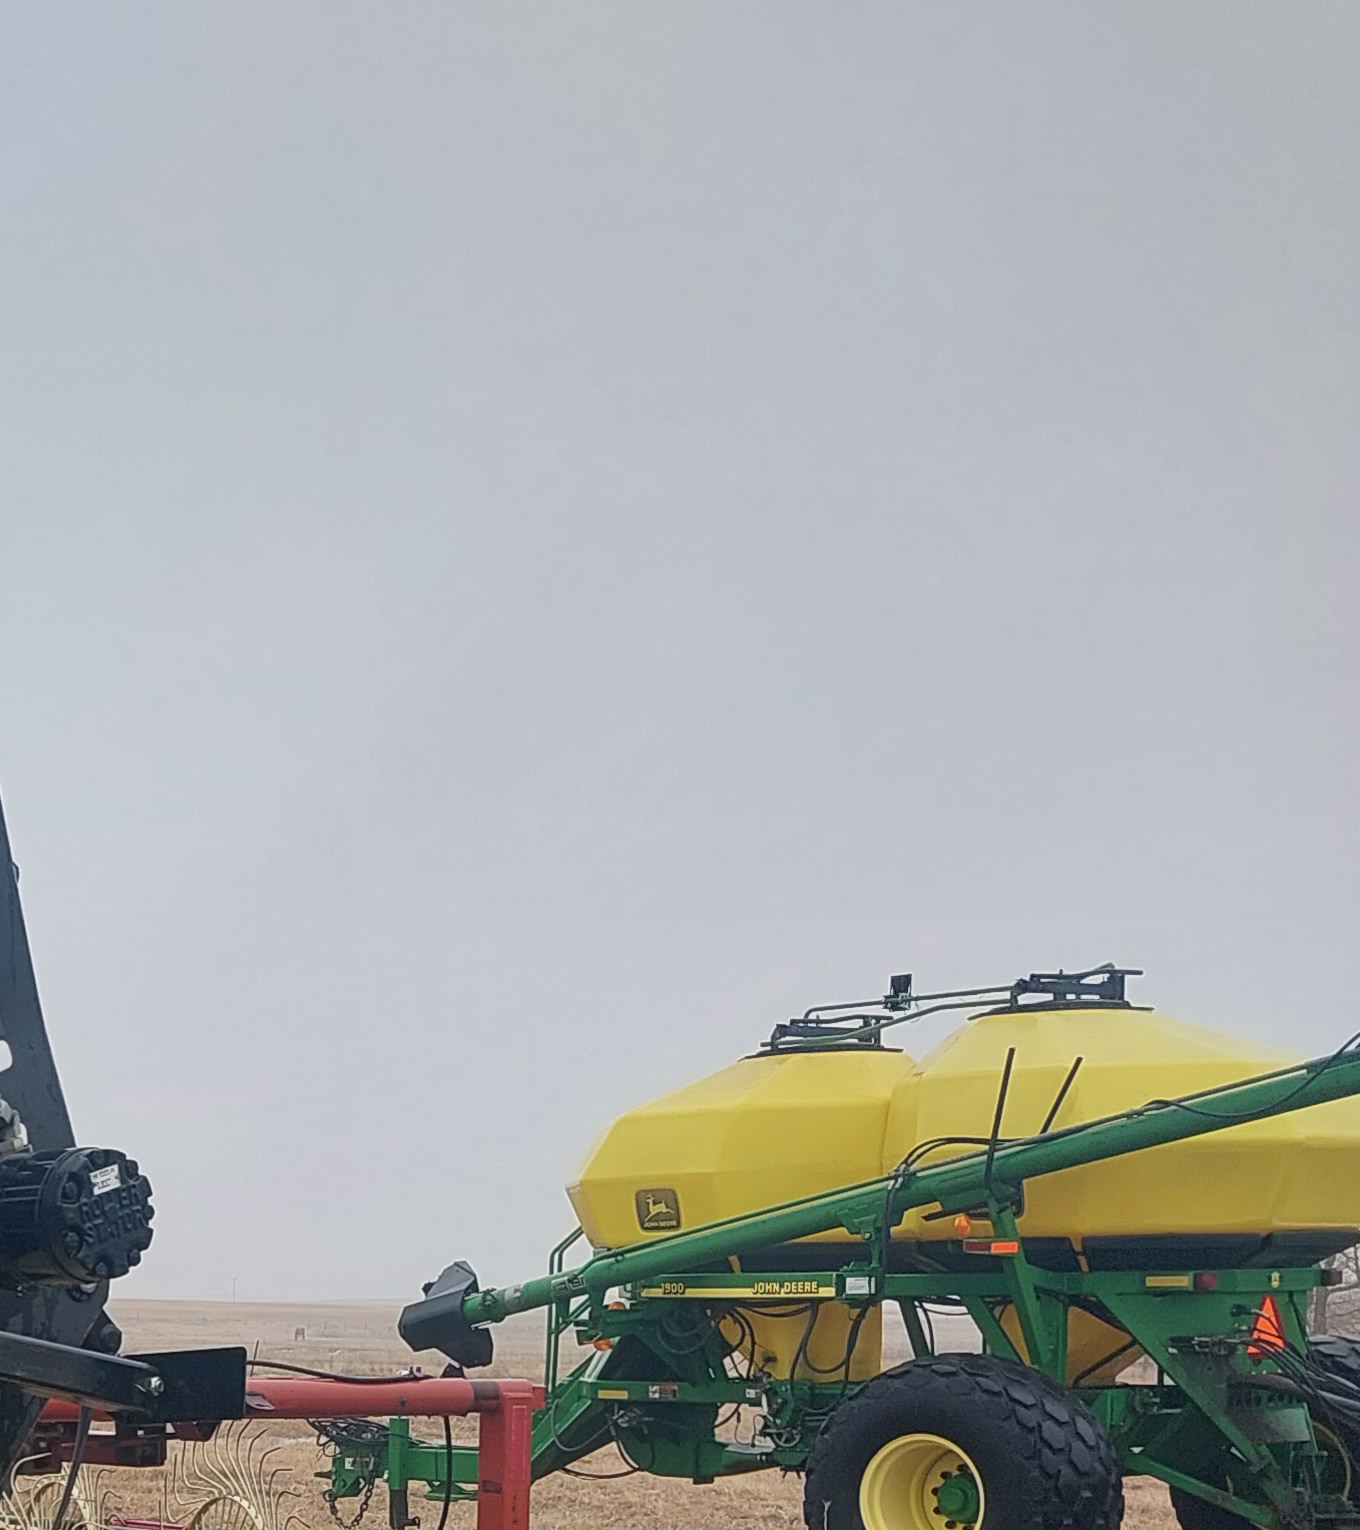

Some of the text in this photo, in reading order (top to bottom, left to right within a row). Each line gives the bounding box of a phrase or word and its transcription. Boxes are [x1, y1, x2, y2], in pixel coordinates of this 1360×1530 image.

[660, 1281, 818, 1294] 1900 JOHN DEERE
